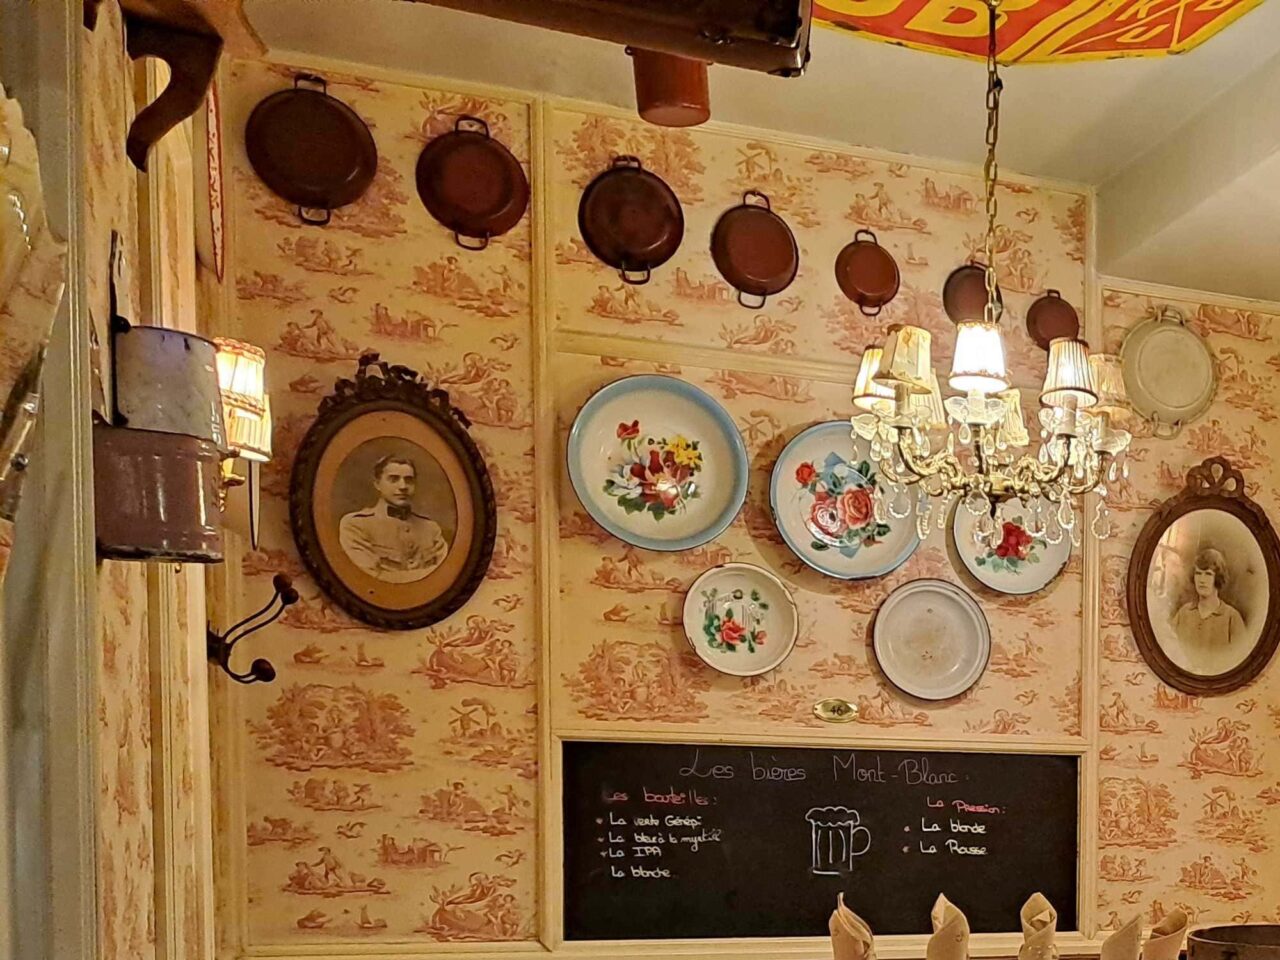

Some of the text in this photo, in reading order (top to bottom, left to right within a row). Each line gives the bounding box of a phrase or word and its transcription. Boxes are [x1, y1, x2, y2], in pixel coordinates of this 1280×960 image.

[679, 748, 734, 779] Les
[750, 751, 807, 781] bières
[927, 796, 944, 808] La
[609, 811, 627, 825] La
[922, 817, 987, 834] La blonde
[608, 831, 625, 843] La
[608, 846, 662, 858] La IPA
[920, 840, 937, 854] La
[610, 865, 671, 878] La blonde
